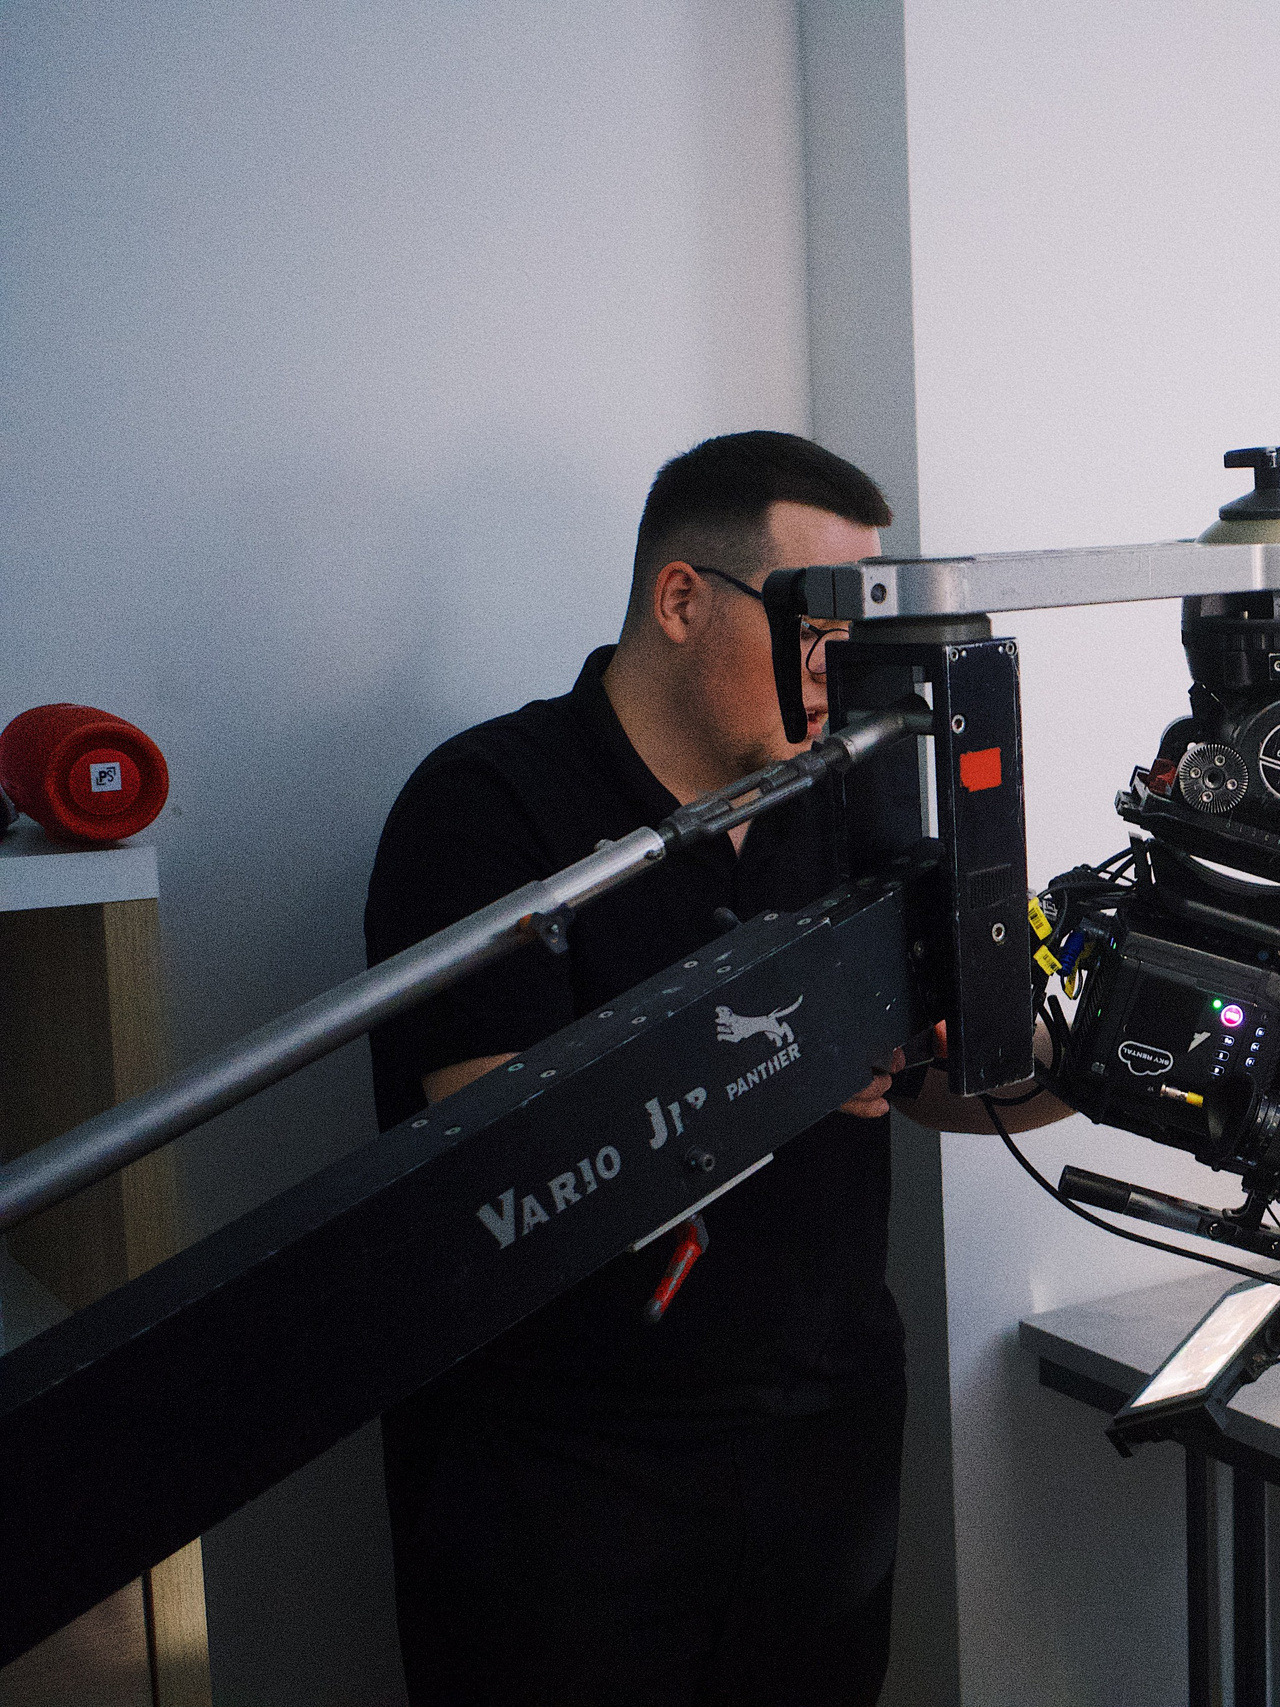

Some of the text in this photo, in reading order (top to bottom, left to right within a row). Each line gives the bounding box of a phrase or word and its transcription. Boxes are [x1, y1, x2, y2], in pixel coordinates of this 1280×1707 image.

[726, 1043, 801, 1101] PANTHER
[1122, 1047, 1171, 1066] SKY RENTAL
[475, 1145, 622, 1250] VARIO
